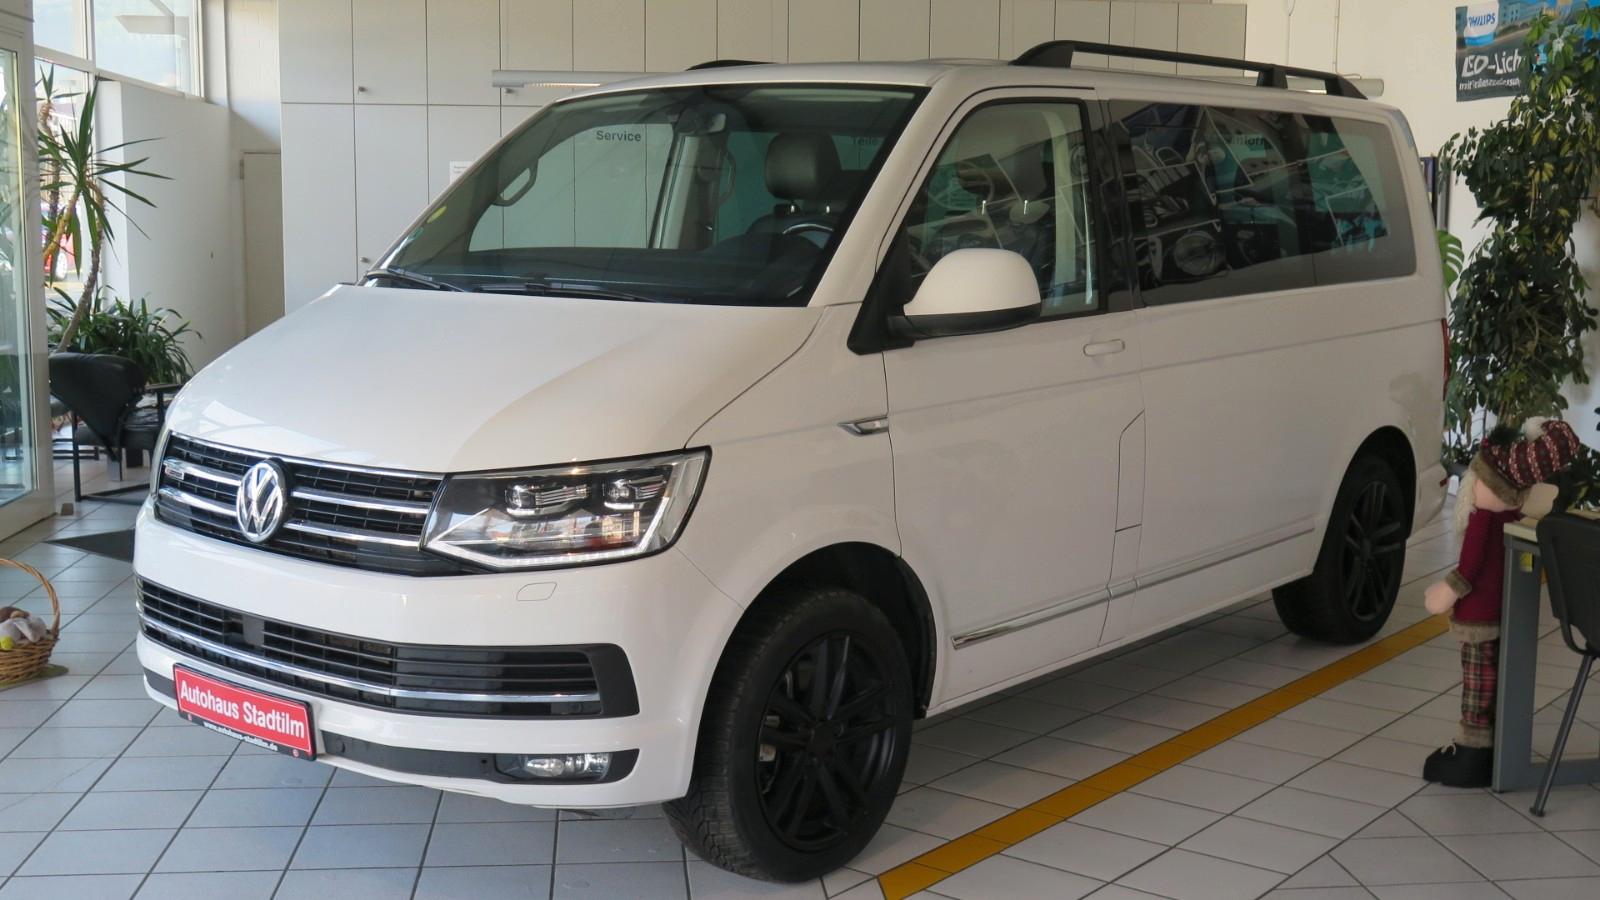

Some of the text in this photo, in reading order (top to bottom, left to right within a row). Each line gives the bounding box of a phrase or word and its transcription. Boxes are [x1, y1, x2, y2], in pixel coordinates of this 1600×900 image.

[1468, 13, 1496, 28] PHILIPS
[596, 129, 642, 142] Service
[180, 680, 305, 739] Autohaus Stadtilm
